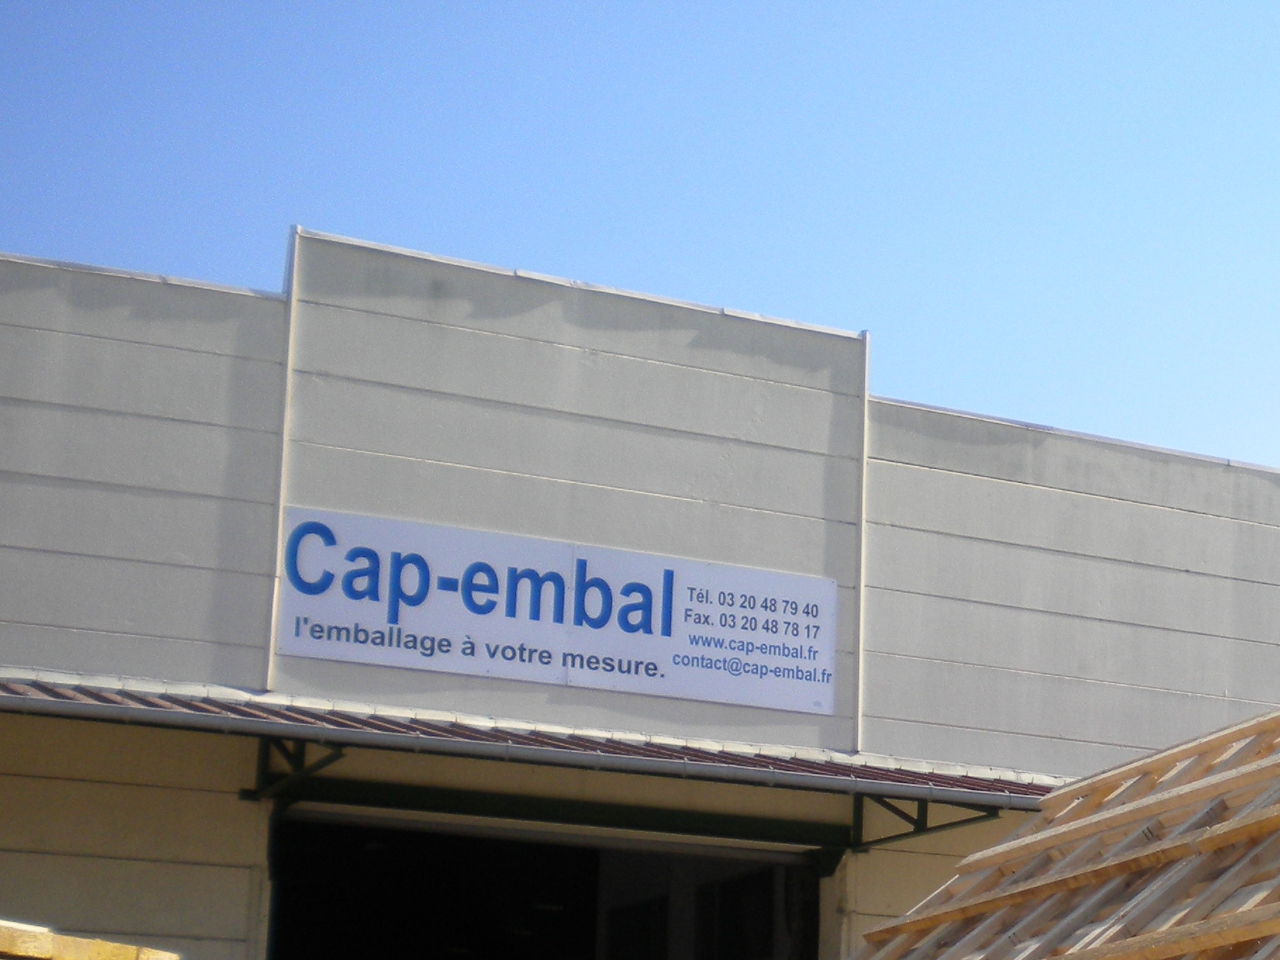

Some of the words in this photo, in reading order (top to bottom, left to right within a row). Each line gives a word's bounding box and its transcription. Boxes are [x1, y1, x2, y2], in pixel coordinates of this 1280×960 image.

[284, 521, 675, 637] Cap-embal
[687, 587, 713, 605] Tél.
[718, 591, 735, 607] 03
[739, 594, 756, 610] 20
[760, 597, 777, 612] 48
[782, 600, 798, 615] 79
[802, 603, 819, 618] 40
[684, 608, 714, 626] Fax.
[719, 613, 736, 628] 03
[741, 616, 757, 631] 20
[762, 619, 778, 634] 48
[783, 621, 799, 637] 78
[804, 624, 820, 639] 17
[294, 616, 452, 657] l'emballage
[461, 635, 475, 657] à
[485, 643, 552, 665] votre
[561, 651, 665, 678] mesure.
[688, 634, 819, 661] www.cap-embal.fr
[672, 654, 832, 684] contact@cap-embal.fr
